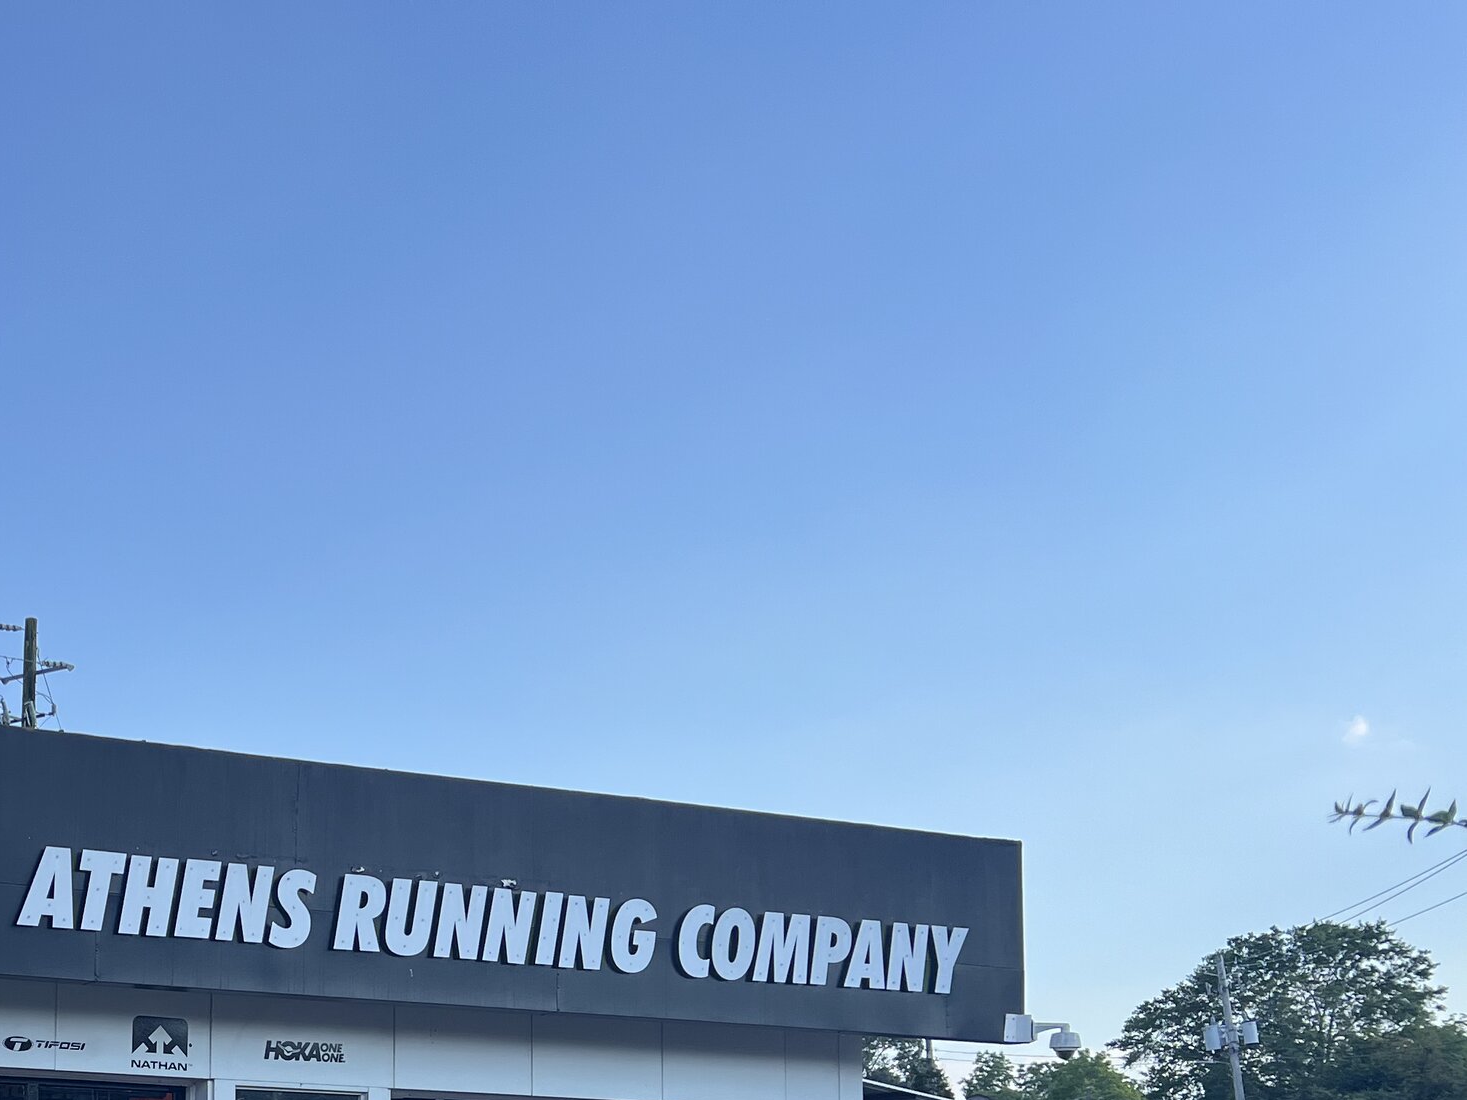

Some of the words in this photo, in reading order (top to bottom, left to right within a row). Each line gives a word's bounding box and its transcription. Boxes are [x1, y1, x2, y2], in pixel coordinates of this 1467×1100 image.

[15, 845, 318, 951] ATHENS
[332, 873, 657, 975] RUNNING
[677, 903, 970, 995] COMPANY
[36, 1039, 86, 1052] TIFOSI
[264, 1039, 322, 1063] HOKA
[320, 1042, 342, 1054] ONE
[322, 1052, 345, 1064] ONE
[131, 1060, 189, 1072] NATHAN
